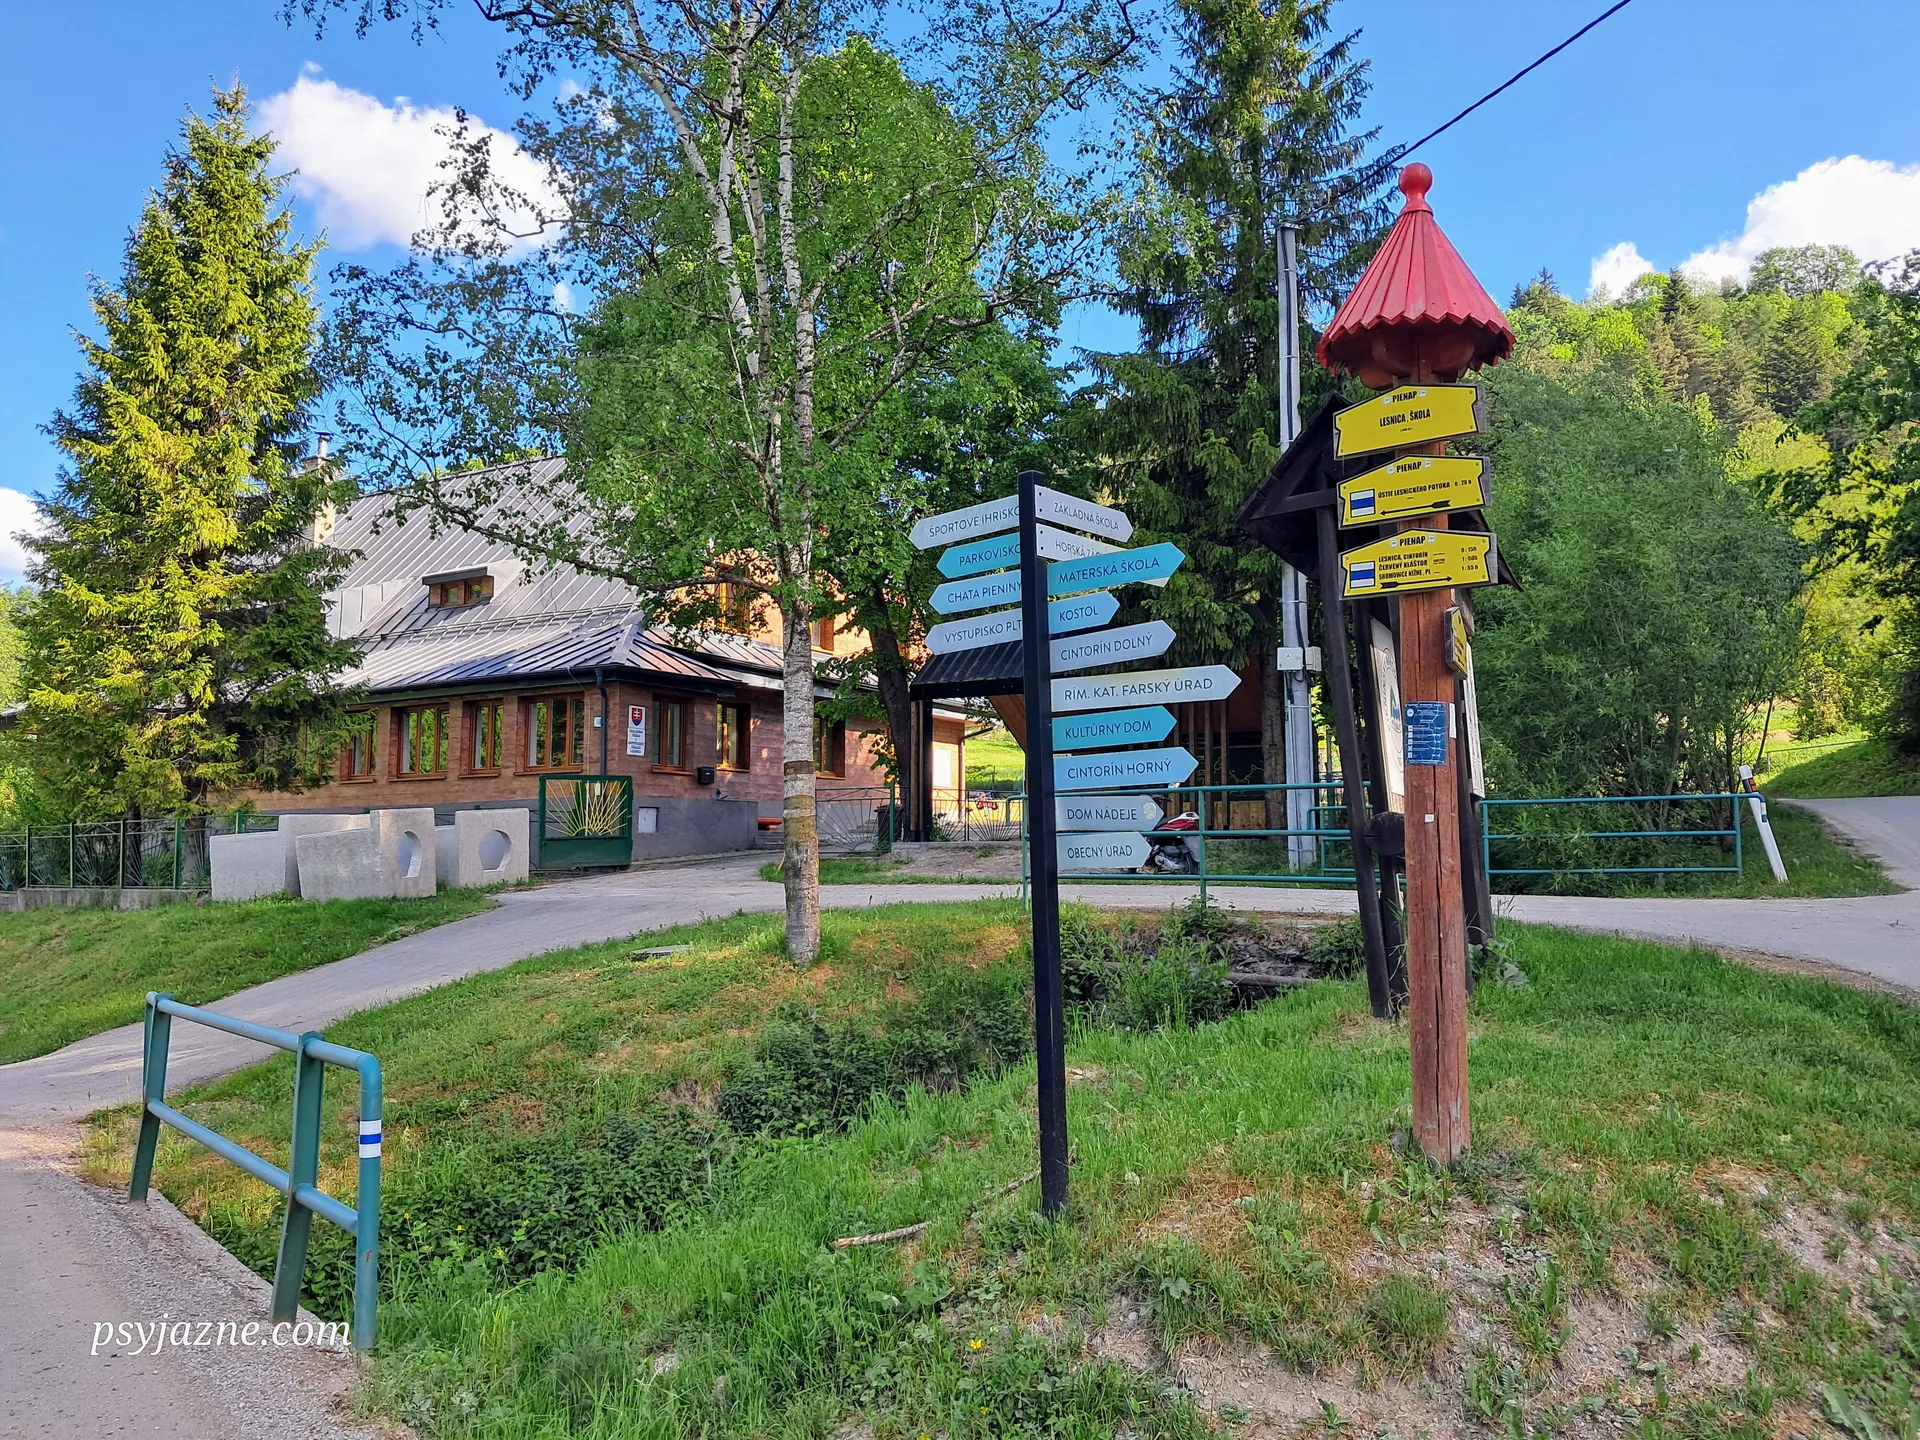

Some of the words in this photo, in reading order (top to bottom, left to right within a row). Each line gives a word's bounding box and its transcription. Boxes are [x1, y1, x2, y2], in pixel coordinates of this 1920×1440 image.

[1392, 391, 1417, 403] PIENAP
[1409, 408, 1431, 421] ŠKOLA
[1396, 461, 1422, 473] PIENAP
[1428, 481, 1450, 491] POTOKA
[929, 514, 980, 538] ŠPORTOVÉ
[981, 506, 1019, 524] IHRISKO
[1053, 501, 1094, 524] ZÁKLADNÁ
[1095, 513, 1119, 531] ŠKOLA
[1055, 540, 1085, 557] HORSKÁ
[1399, 535, 1426, 547] PIENAP
[959, 544, 1020, 566] PARKOVISKO
[1058, 561, 1118, 584] MATERSKÁ
[1120, 557, 1160, 573] ŠKOLA
[947, 589, 980, 604] CHATA
[982, 582, 1021, 597] PIENINY
[1059, 605, 1099, 622] KOSTOL
[944, 623, 1004, 642] VÝSTUPISKO
[1060, 640, 1111, 661] CINTORÍN
[1114, 632, 1152, 652] DOLNÝ
[1064, 687, 1090, 701] RÍM.
[1093, 686, 1118, 699] KAT.
[1122, 679, 1171, 695] FARSKÝ
[1174, 677, 1213, 691] ÚRAD
[1065, 719, 1121, 739] KULTÚRNY
[1124, 720, 1152, 734] DOM
[1067, 763, 1123, 780] CINTORÍN
[1127, 757, 1172, 775] HORNÝ
[1067, 808, 1093, 820] DOM
[1095, 804, 1137, 820] NÁDEJE
[1067, 843, 1104, 859] OBECNÝ
[1106, 842, 1133, 857] ÚRAD
